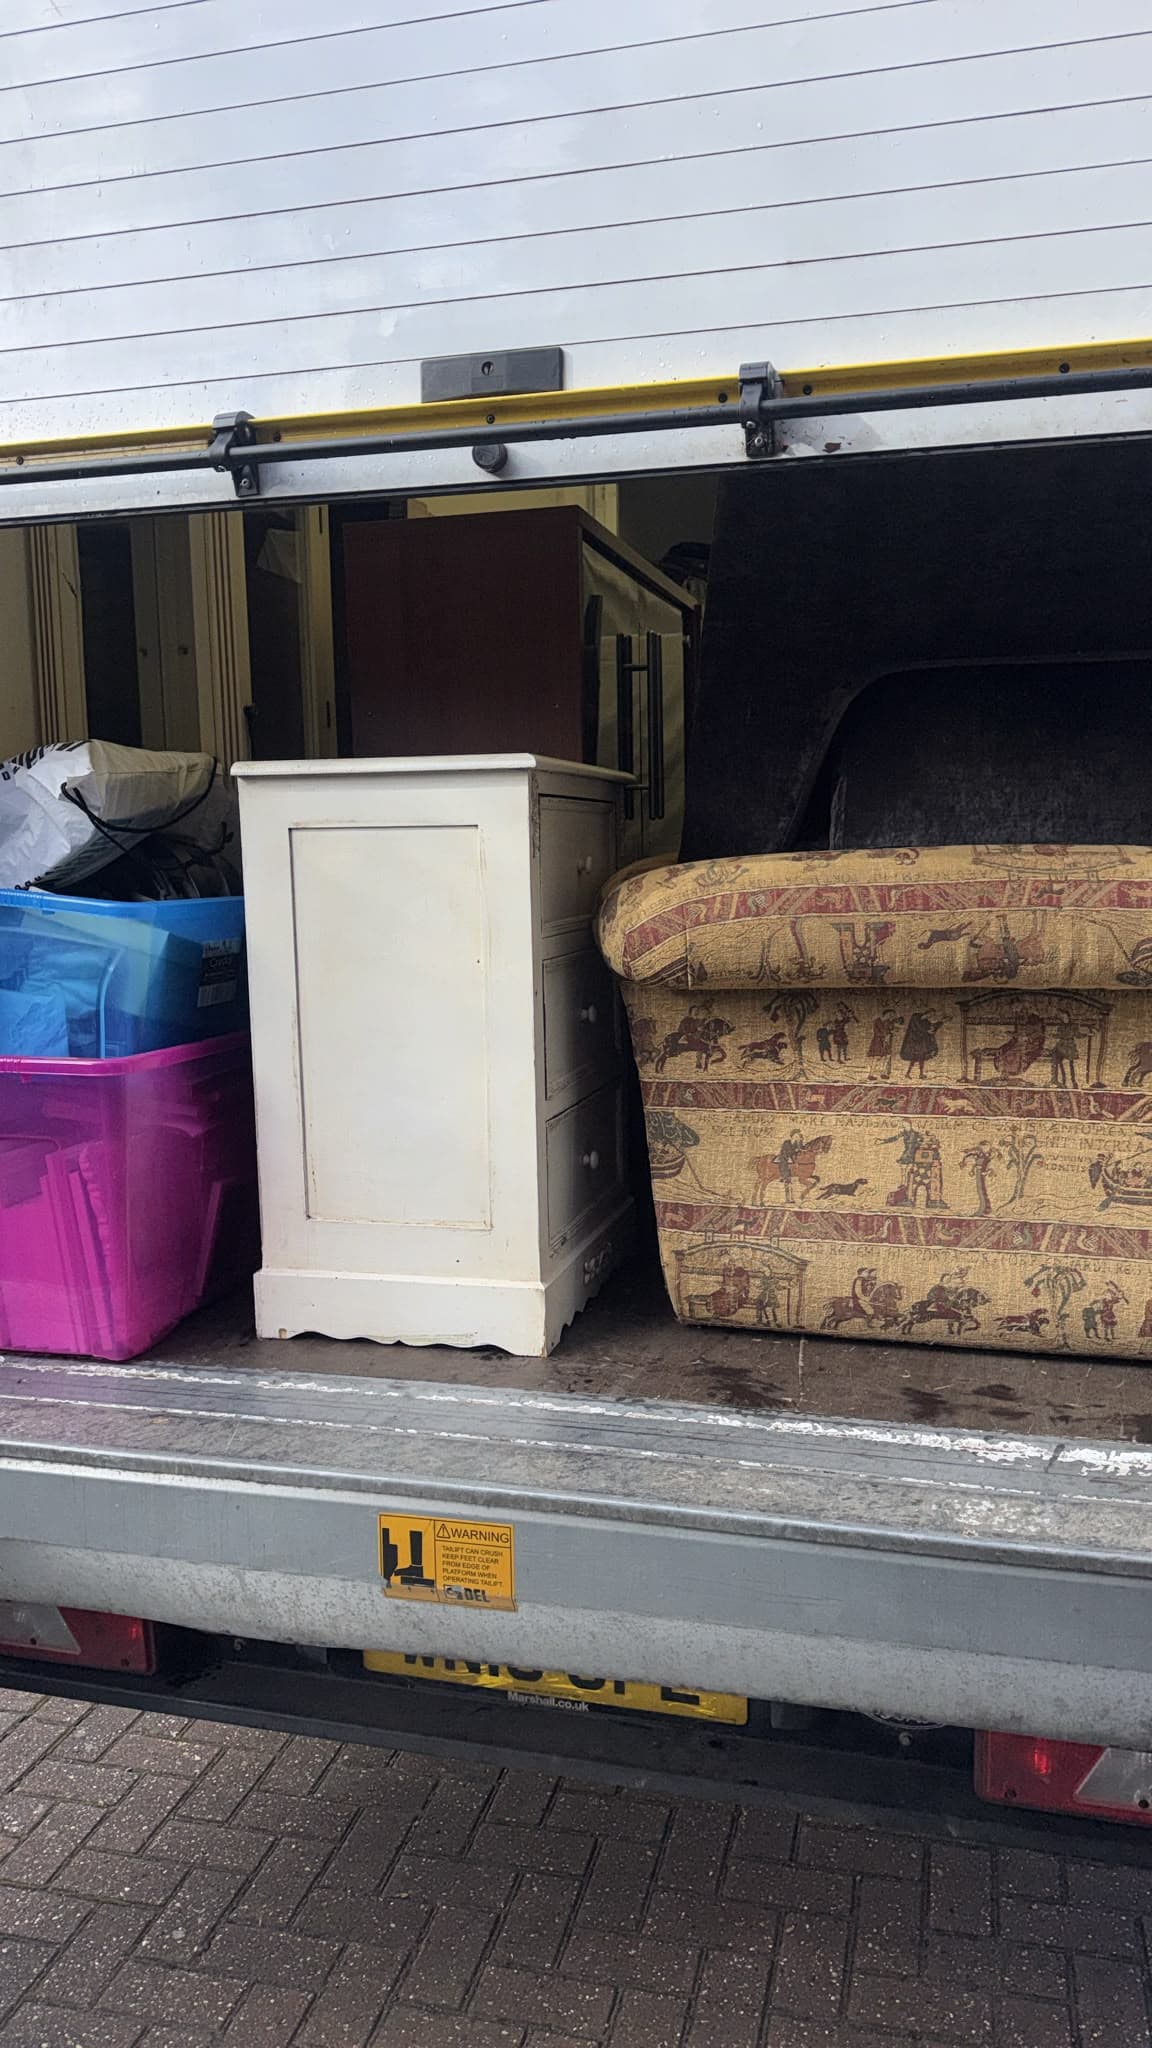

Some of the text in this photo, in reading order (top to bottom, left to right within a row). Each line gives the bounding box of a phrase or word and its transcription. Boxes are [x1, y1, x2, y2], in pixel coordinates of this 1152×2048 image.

[450, 1527, 510, 1544] WARNING
[480, 1549, 503, 1557] CRUSH
[442, 1560, 461, 1568] FROM
[462, 1562, 480, 1570] EDGE
[477, 1557, 499, 1565] CLEAR
[442, 1568, 497, 1579] PLATFORM WHEN
[442, 1575, 479, 1585] OPERATING
[507, 1691, 590, 1712] Marshall.co.uk
